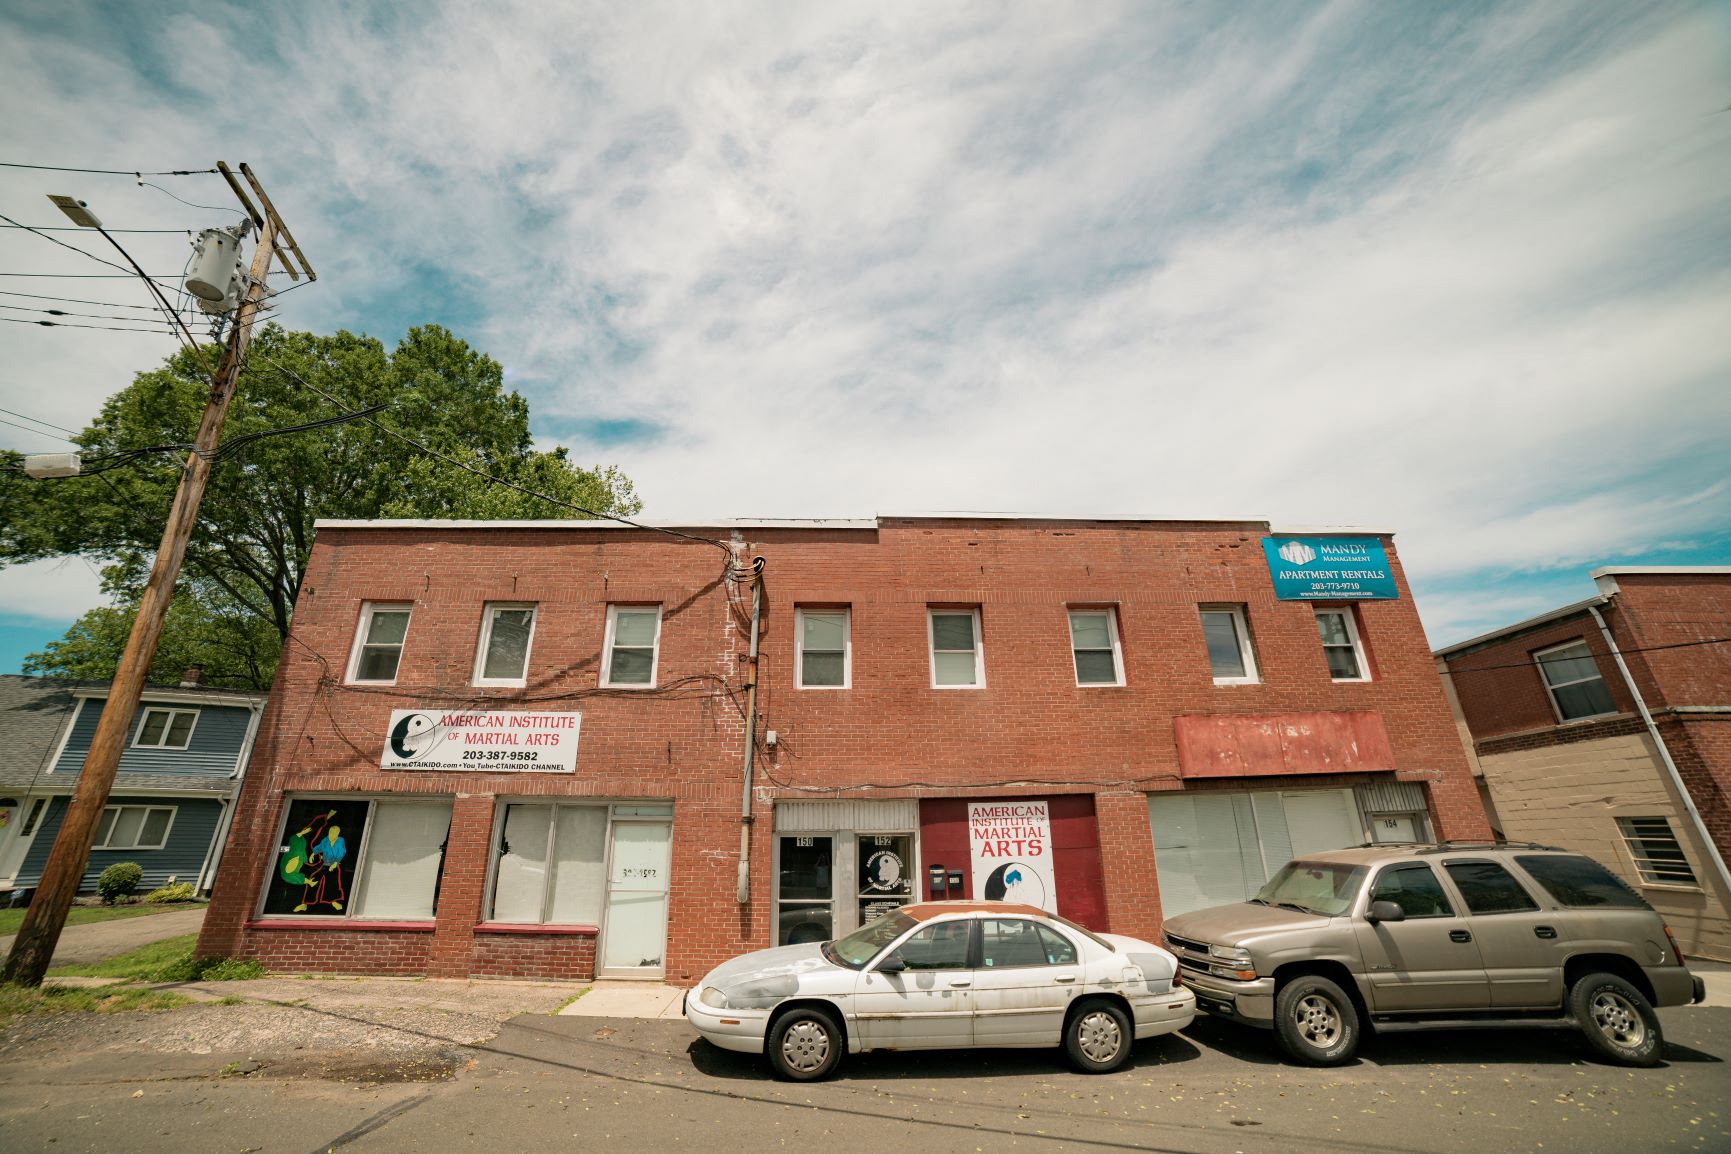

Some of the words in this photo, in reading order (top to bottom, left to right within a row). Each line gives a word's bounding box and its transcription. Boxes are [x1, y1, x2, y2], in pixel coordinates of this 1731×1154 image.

[1320, 544, 1366, 555] MANDY
[1279, 570, 1339, 580] APARTMENT
[1341, 570, 1385, 579] RENTALS
[1311, 582, 1360, 590] 203-773-9710
[439, 714, 505, 728] AMERICAN
[509, 715, 576, 729] INSTITUTE
[447, 732, 460, 741] OF
[464, 732, 520, 745] MARTIAL
[525, 733, 560, 746] ARTS
[462, 750, 538, 761] 203-387-9582
[390, 761, 458, 769] www.CTAIKIDO.com
[531, 763, 565, 771] CHANNEL
[972, 805, 1045, 818] AMERICAN
[972, 817, 1033, 827] INSTITUTE
[1384, 819, 1398, 828] 154
[974, 826, 1046, 840] MARTIAL
[798, 837, 813, 846] 150
[876, 836, 891, 845] 152
[980, 839, 1043, 858] ARTS
